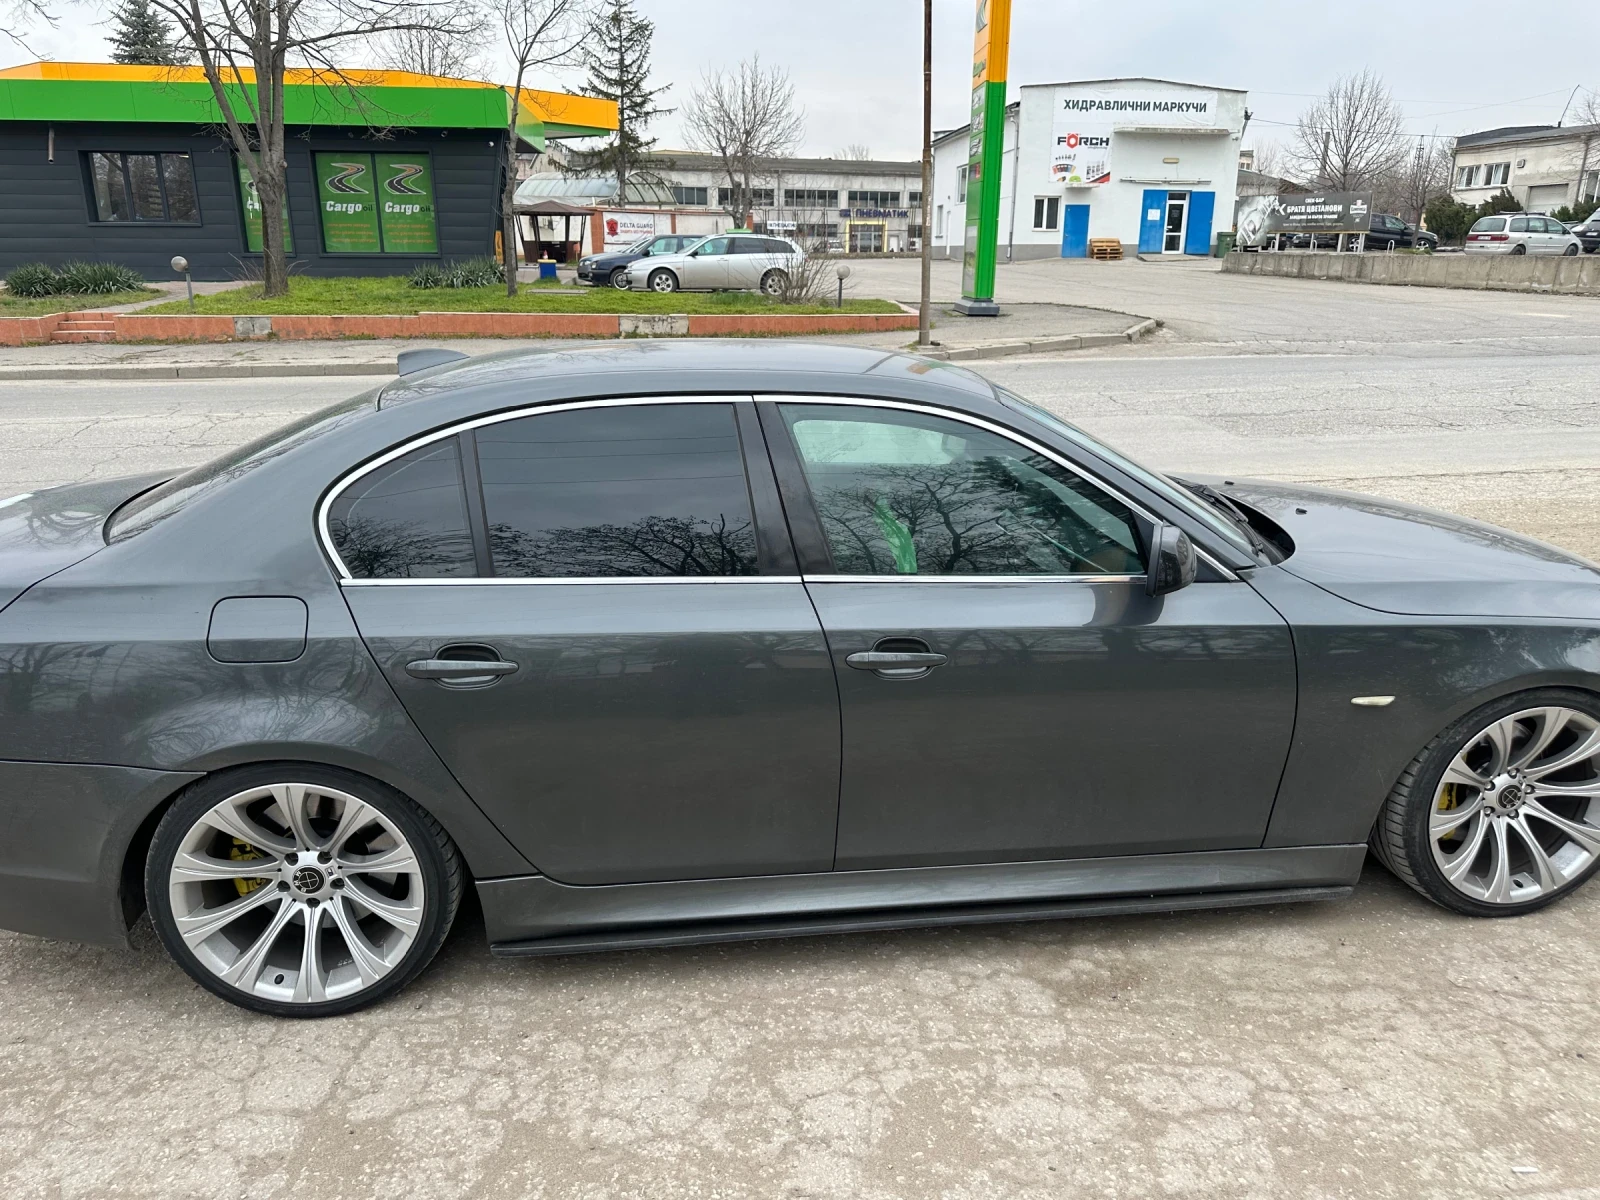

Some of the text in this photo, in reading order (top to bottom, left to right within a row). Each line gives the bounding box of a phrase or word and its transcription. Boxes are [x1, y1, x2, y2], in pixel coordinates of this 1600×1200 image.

[1064, 99, 1207, 112] ХИДРАВЛИЧНИ МАРКУЧИ
[326, 200, 363, 214] Cargo
[385, 202, 420, 215] Cargo
[856, 208, 909, 218] ПНЕВМАТИК
[1306, 204, 1342, 214] ЦВЕТАНОВИ
